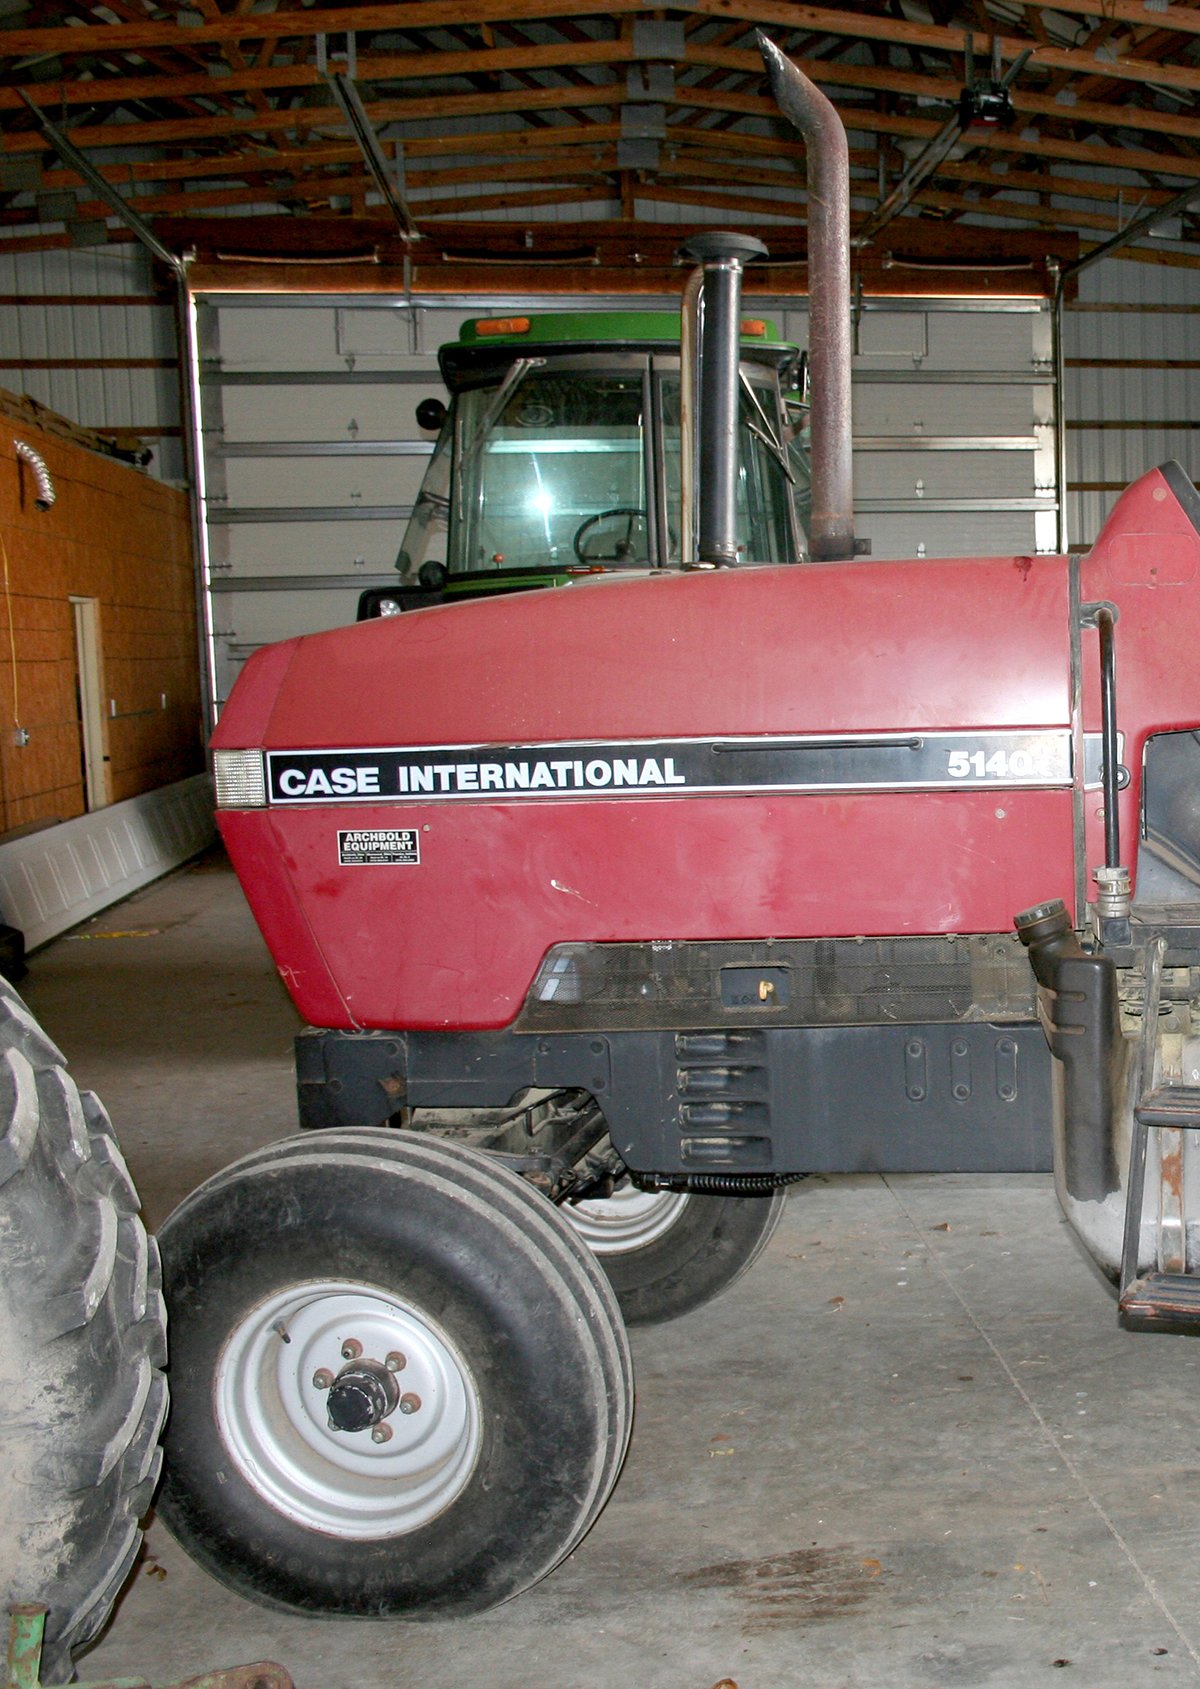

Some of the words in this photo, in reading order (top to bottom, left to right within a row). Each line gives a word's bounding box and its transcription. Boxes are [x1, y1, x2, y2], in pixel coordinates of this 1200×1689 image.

[947, 750, 1034, 778] 5140
[279, 767, 381, 796] CASE
[398, 757, 686, 793] INTERNATIONAL
[343, 841, 414, 851] EQUIPMENT
[345, 832, 411, 842] ARCHBOLD
